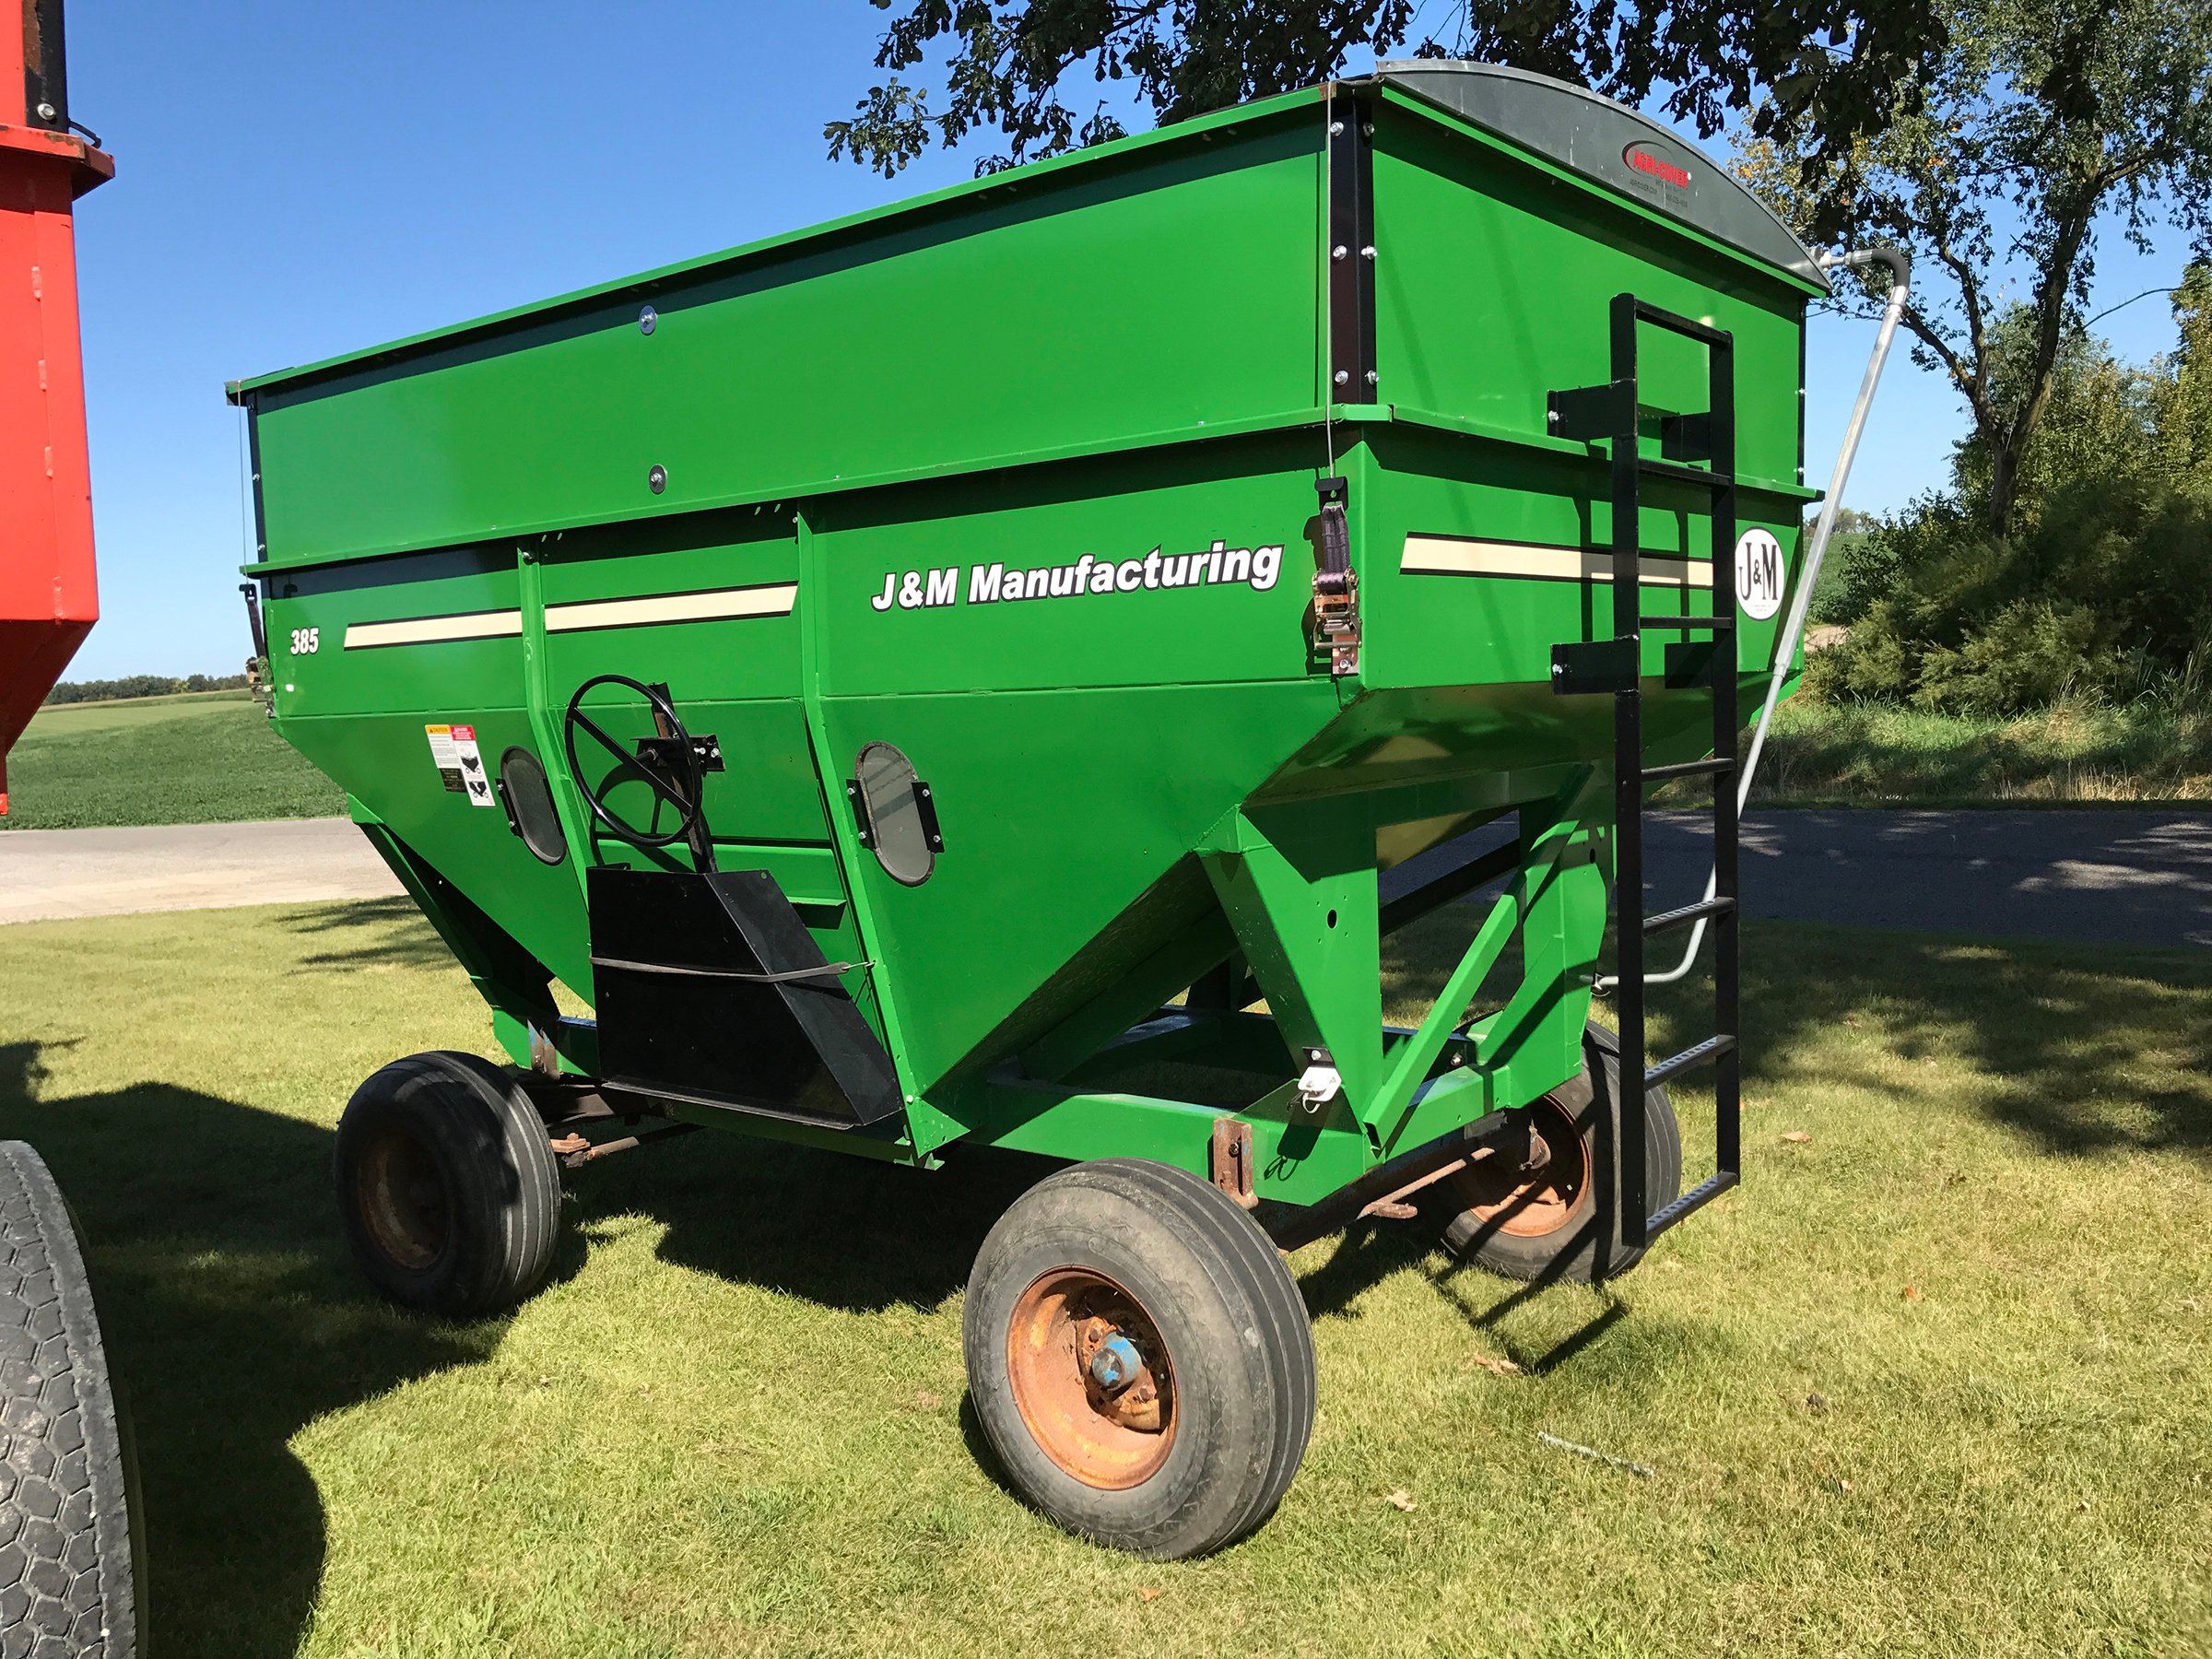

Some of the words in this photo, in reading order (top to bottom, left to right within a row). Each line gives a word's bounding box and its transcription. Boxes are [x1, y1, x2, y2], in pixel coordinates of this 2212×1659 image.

[1633, 149, 1688, 190] AGRI-COVER
[871, 566, 960, 612] J&M
[966, 540, 1285, 605] Manufacturing
[1738, 541, 1778, 601] J&M
[290, 627, 319, 655] 385
